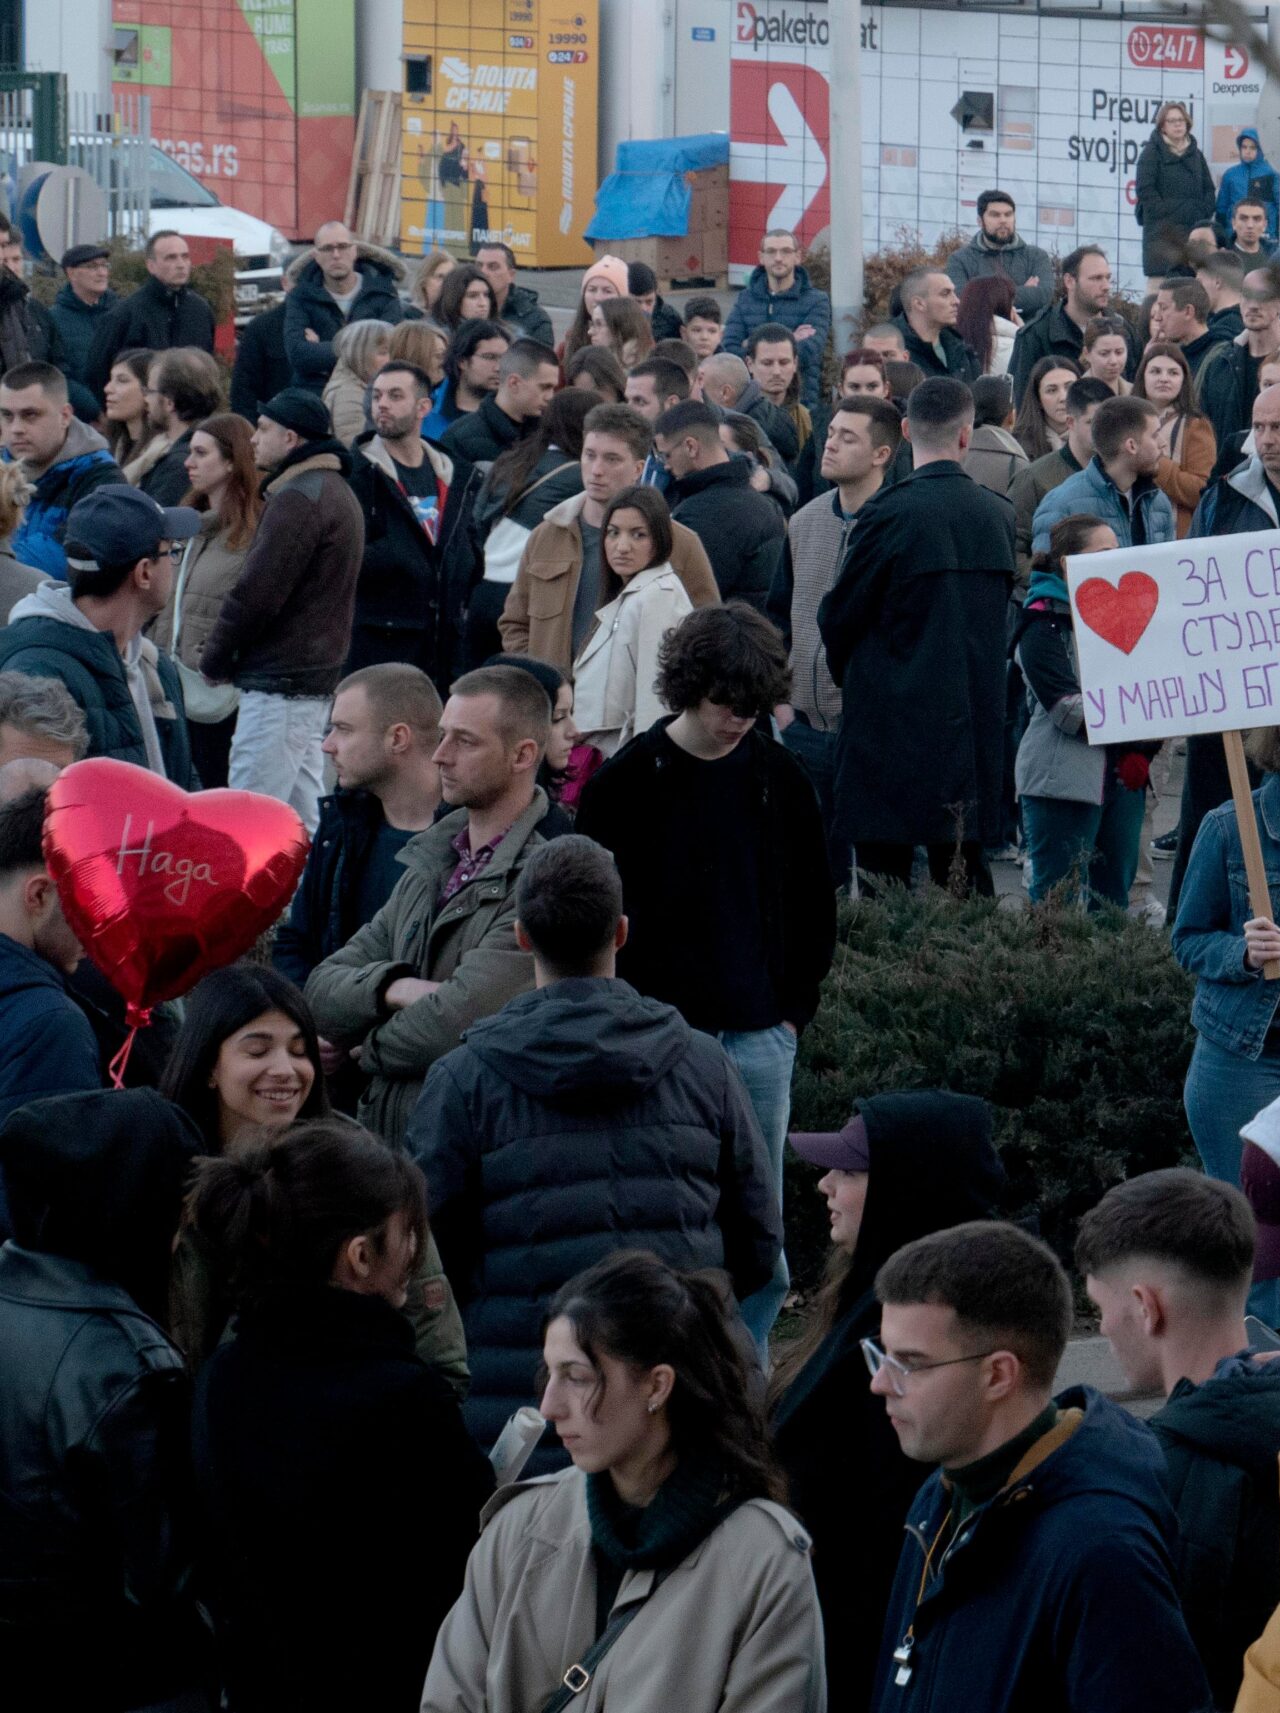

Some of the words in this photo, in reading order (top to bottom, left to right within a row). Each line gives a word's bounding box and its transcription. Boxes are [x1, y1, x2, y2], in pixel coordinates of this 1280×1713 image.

[548, 33, 587, 44] 19990
[1152, 34, 1197, 63] 24/7
[473, 64, 538, 91] ПОШТА
[1212, 82, 1260, 96] Dexpress
[445, 87, 512, 113] СРБИЈЕ
[1092, 88, 1194, 124] Preuzi
[1068, 130, 1117, 173] svoj
[1178, 556, 1227, 606] ЗА
[1087, 687, 1106, 728] У
[1118, 669, 1227, 725] МАРШУ
